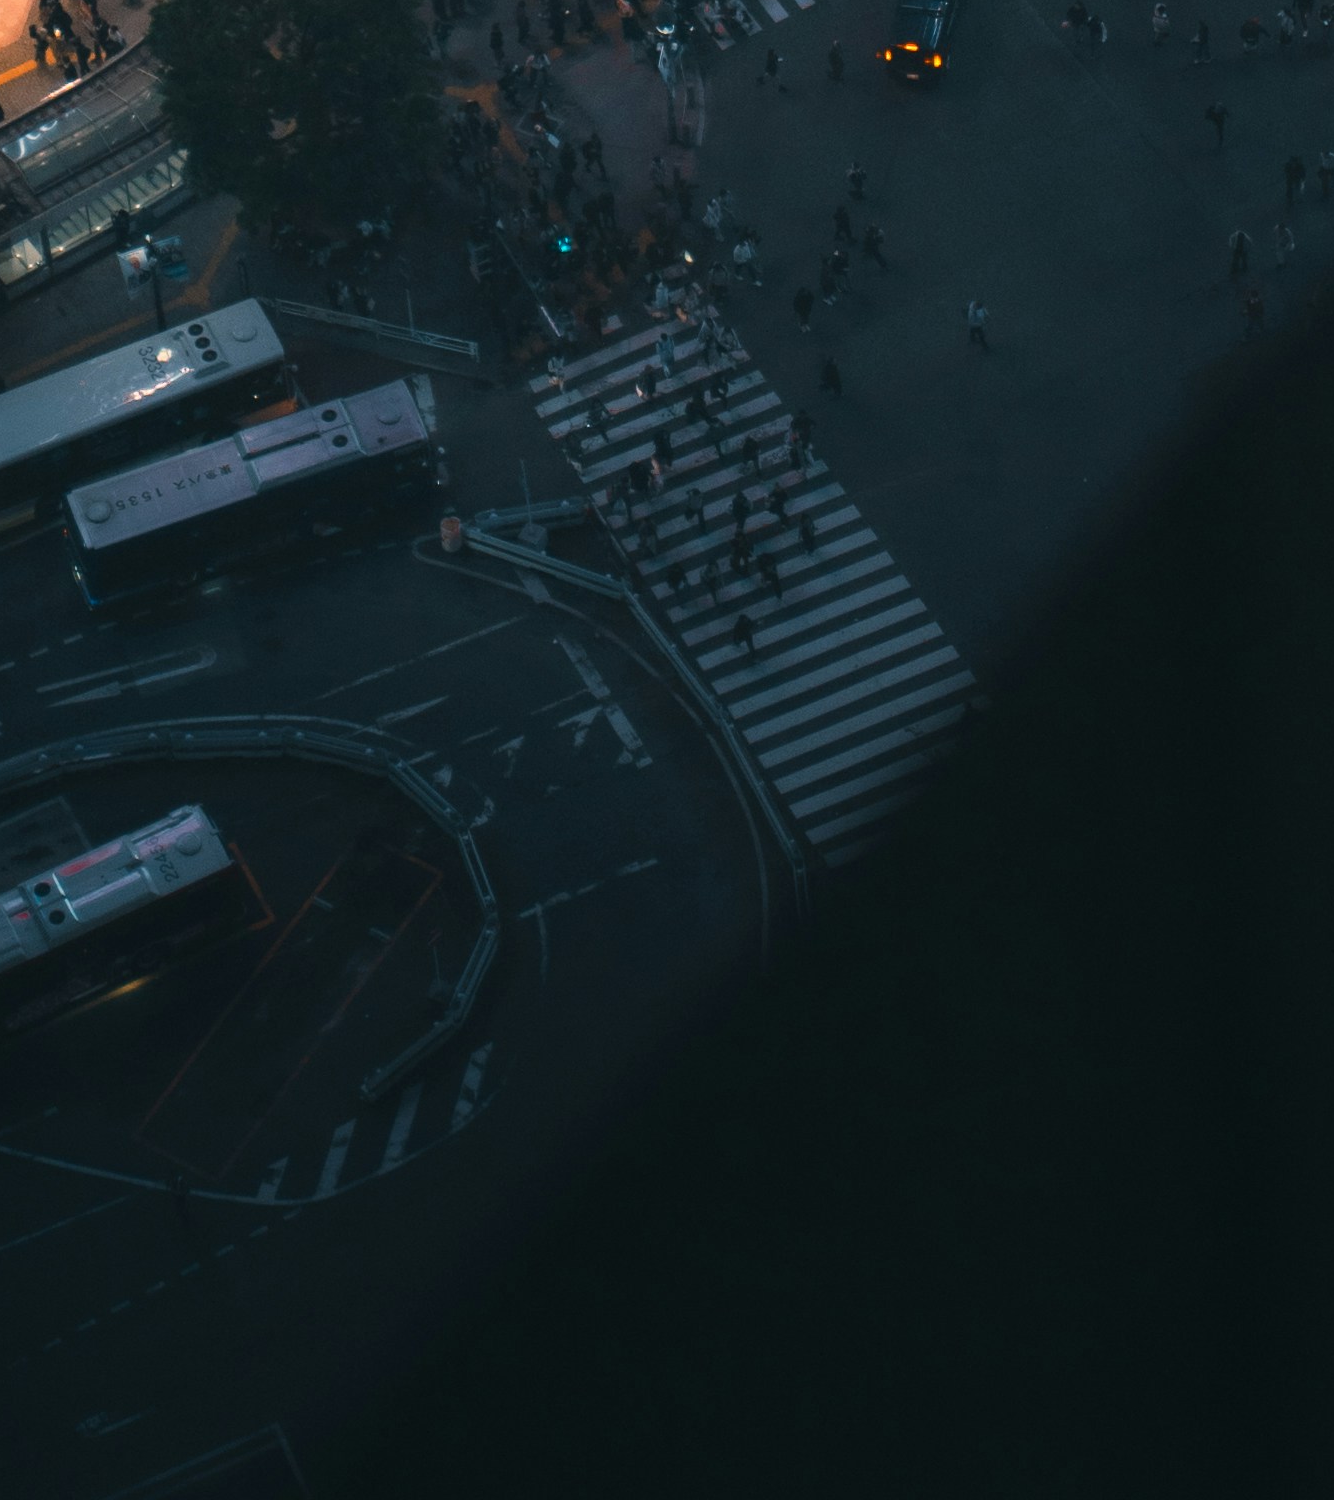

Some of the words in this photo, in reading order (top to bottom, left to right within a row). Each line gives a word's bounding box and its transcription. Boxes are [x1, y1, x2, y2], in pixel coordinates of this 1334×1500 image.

[174, 463, 233, 492] 東急バス
[115, 487, 163, 512] 1535
